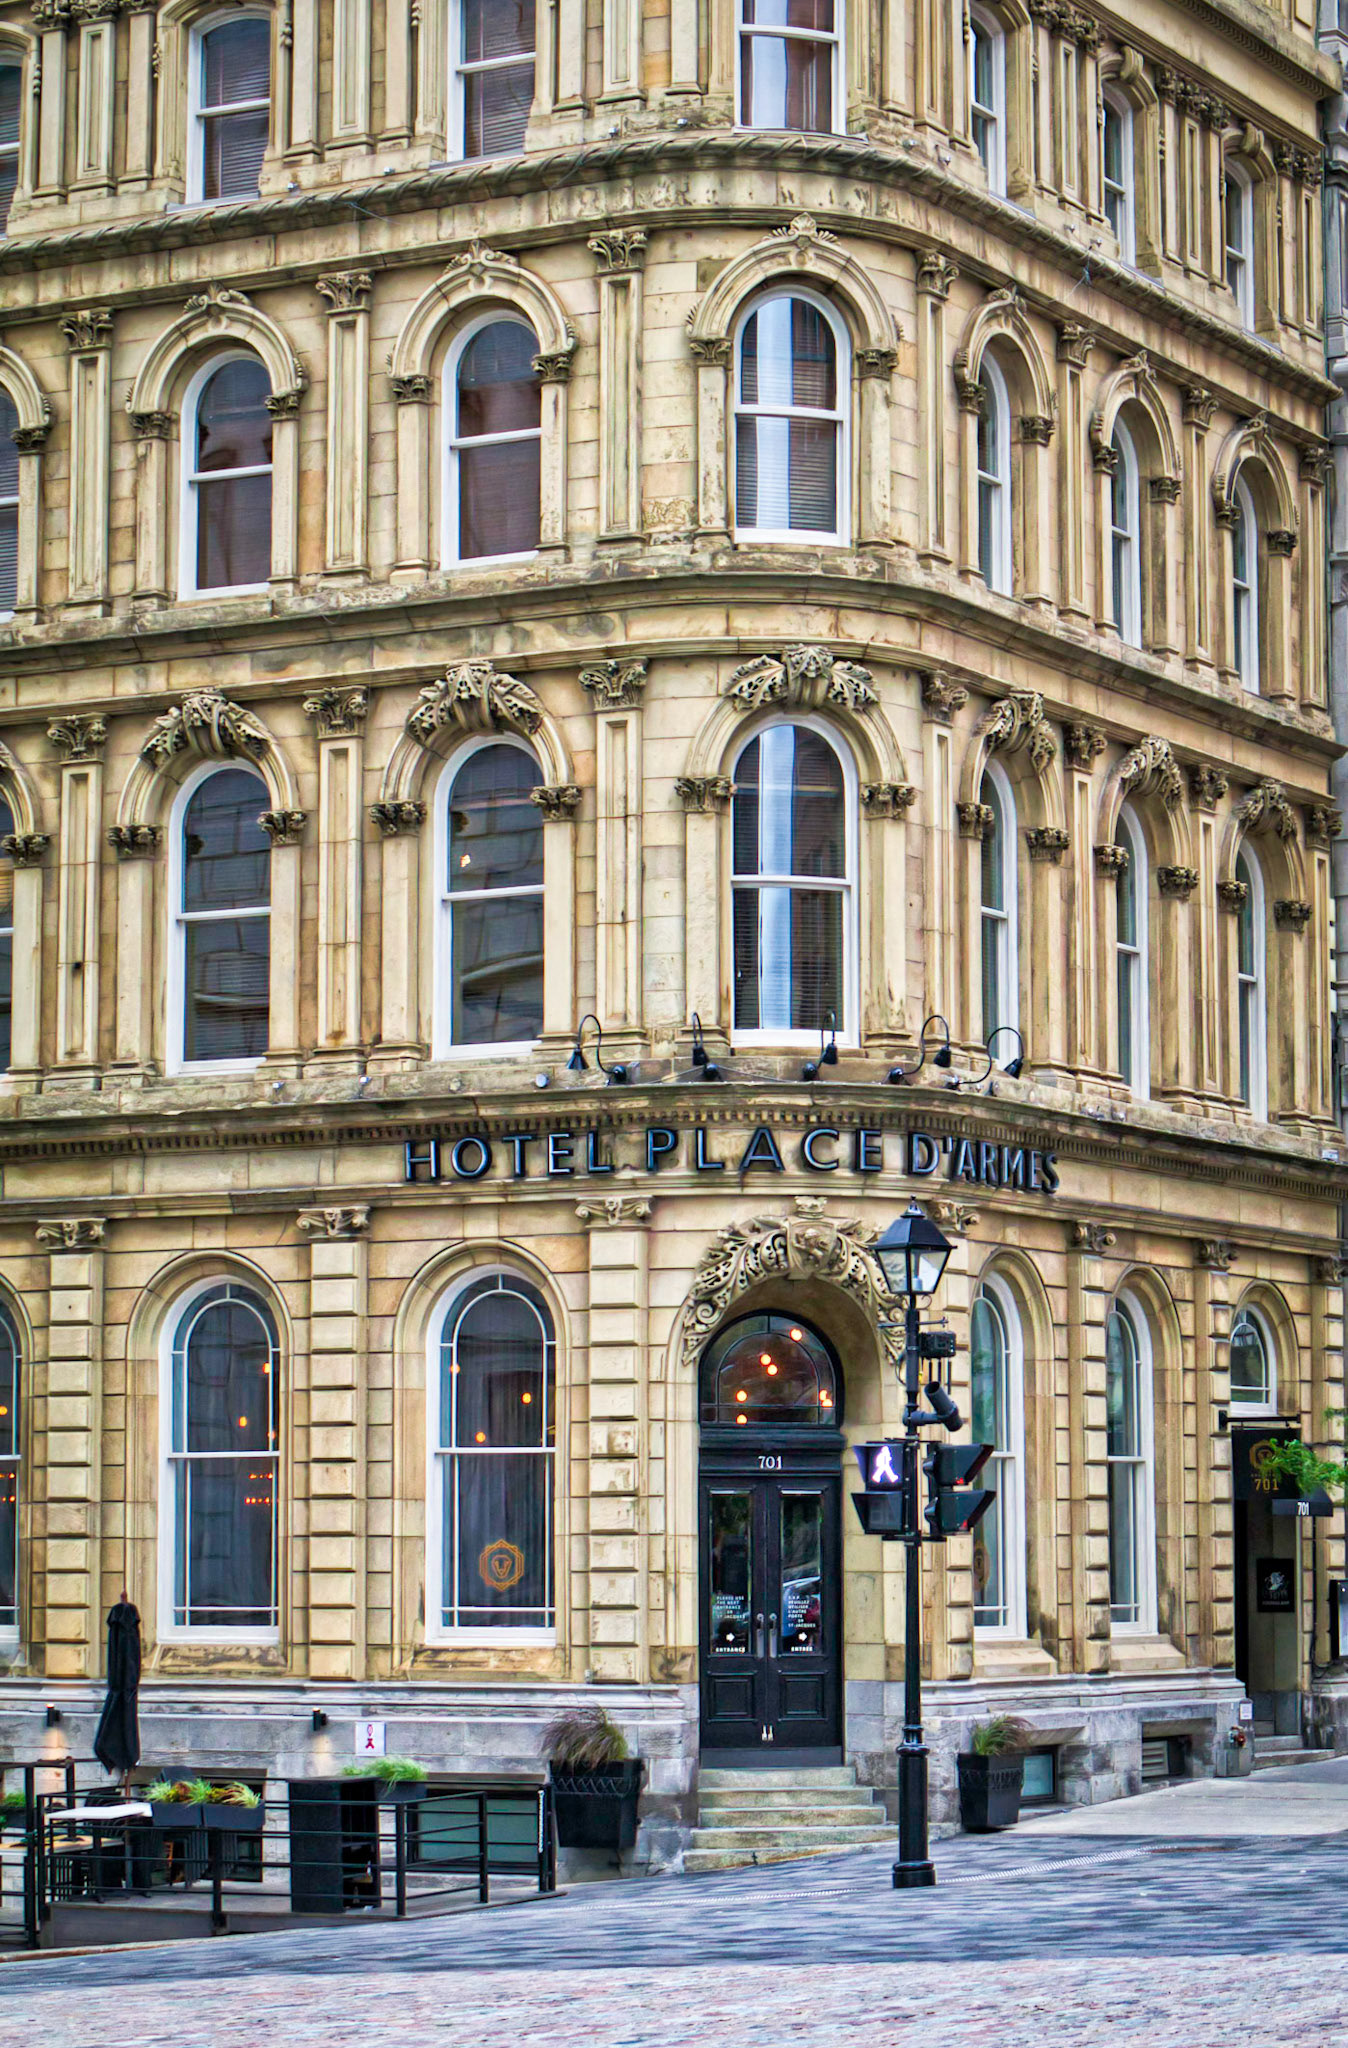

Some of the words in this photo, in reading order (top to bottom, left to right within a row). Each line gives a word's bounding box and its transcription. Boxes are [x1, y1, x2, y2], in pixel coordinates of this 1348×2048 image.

[403, 1130, 617, 1182] HOTEL
[644, 1127, 884, 1173] PLACE
[906, 1130, 1061, 1195] D'ARMES
[757, 1455, 782, 1470] 701
[1254, 1478, 1279, 1491] 701
[1297, 1501, 1310, 1516] 701
